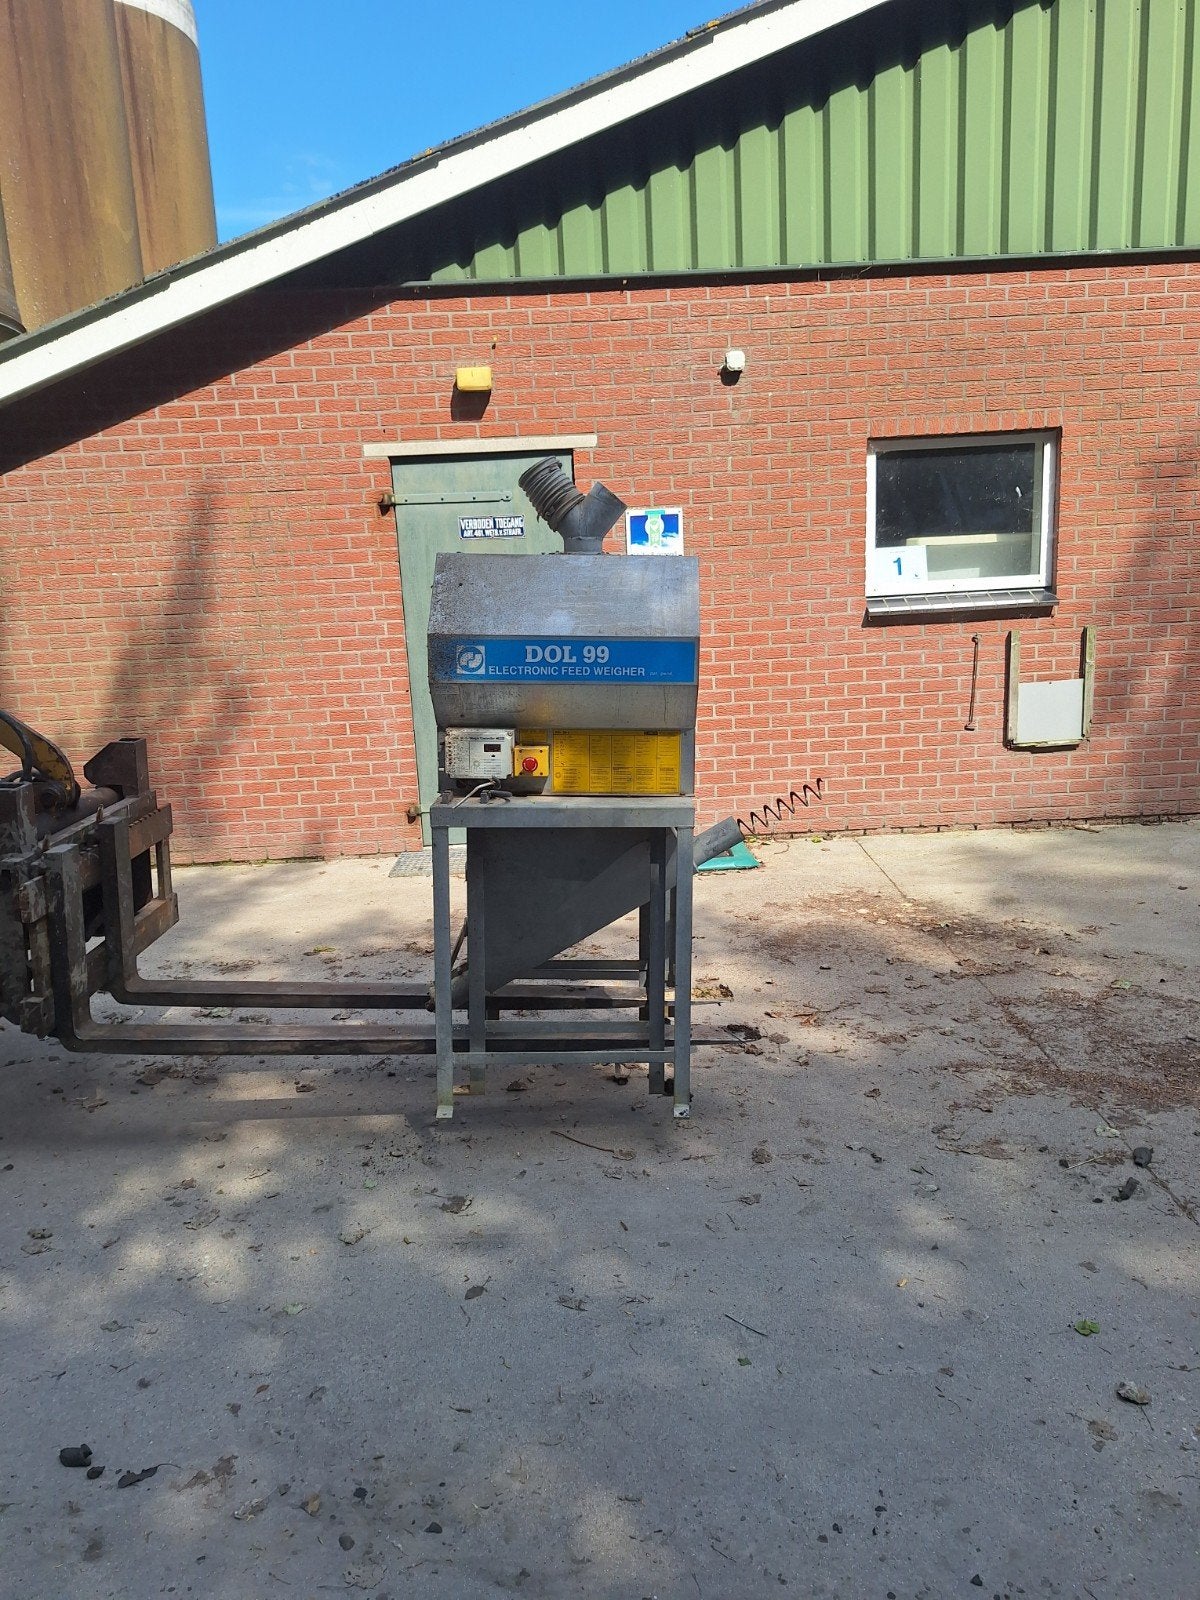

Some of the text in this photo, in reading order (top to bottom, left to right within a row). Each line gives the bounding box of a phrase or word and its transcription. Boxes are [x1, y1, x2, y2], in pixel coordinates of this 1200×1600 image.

[460, 517, 524, 530] VERBODEN TOEGANG
[893, 557, 902, 576] 1
[525, 645, 610, 664] DOL 99
[488, 665, 646, 677] ELECTRONIC FEED WEIGHER
